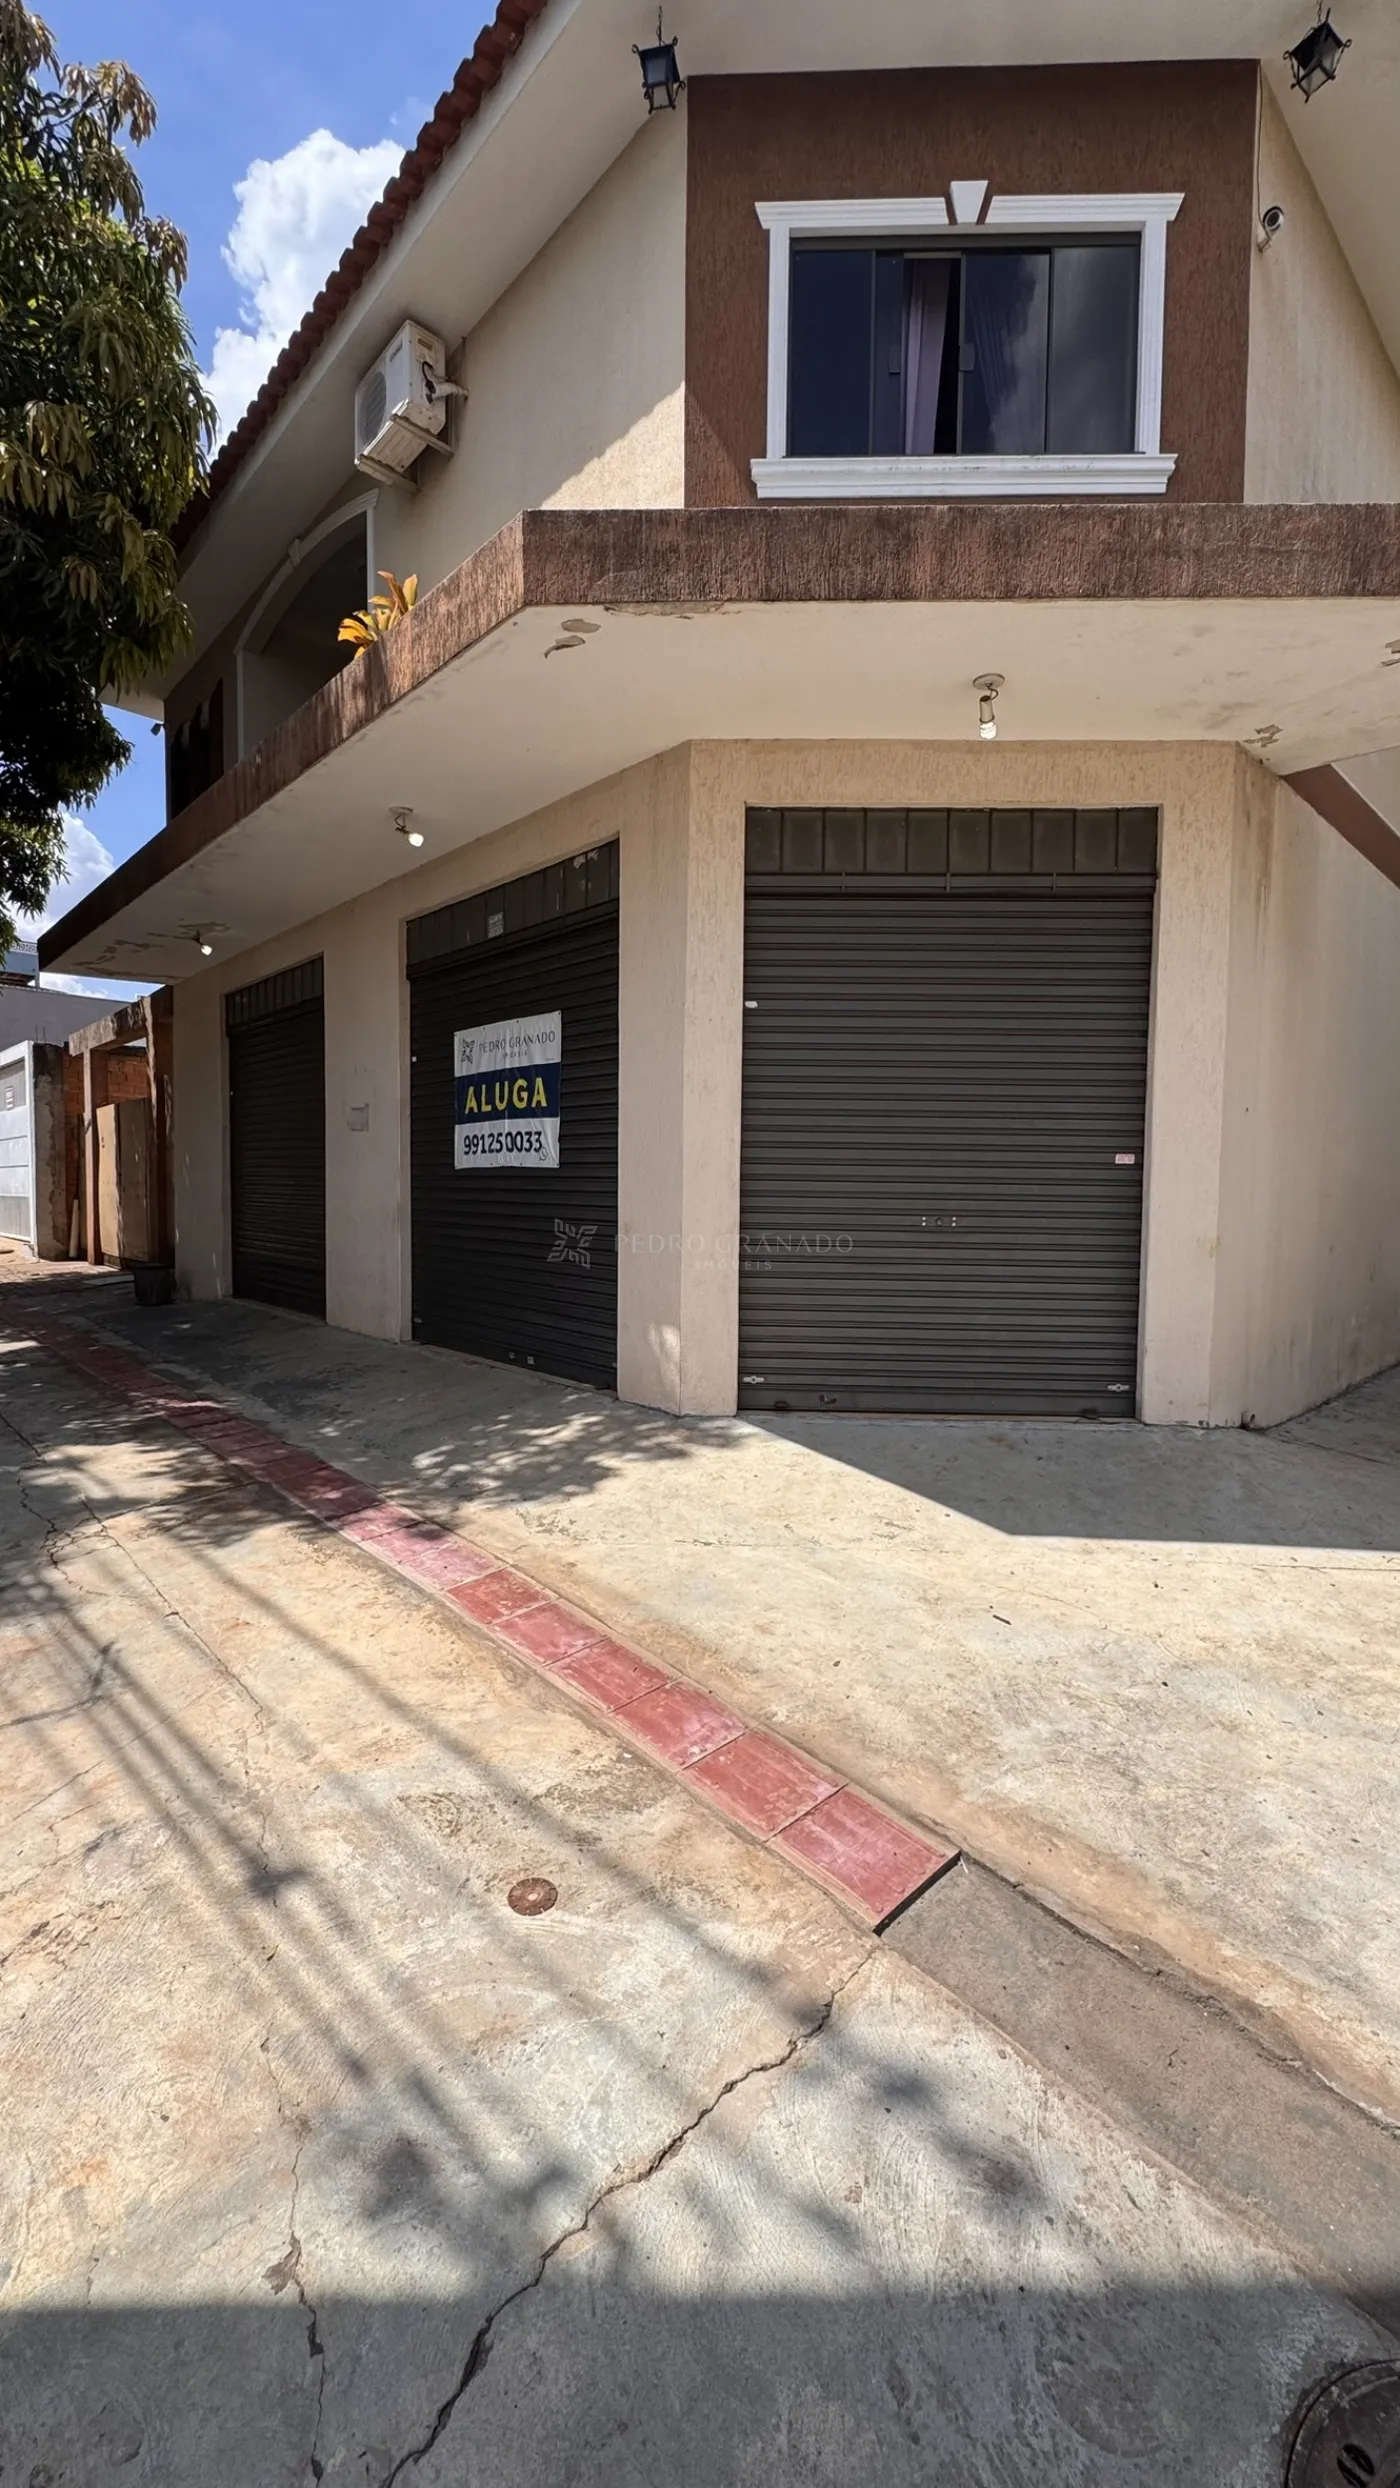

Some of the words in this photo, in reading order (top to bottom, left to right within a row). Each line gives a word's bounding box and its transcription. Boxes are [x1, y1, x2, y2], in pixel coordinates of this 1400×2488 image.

[478, 1038, 506, 1054] PEDRO
[508, 1030, 556, 1049] GRANADO
[464, 1077, 547, 1115] ALUGA
[463, 1131, 543, 1156] 991250033
